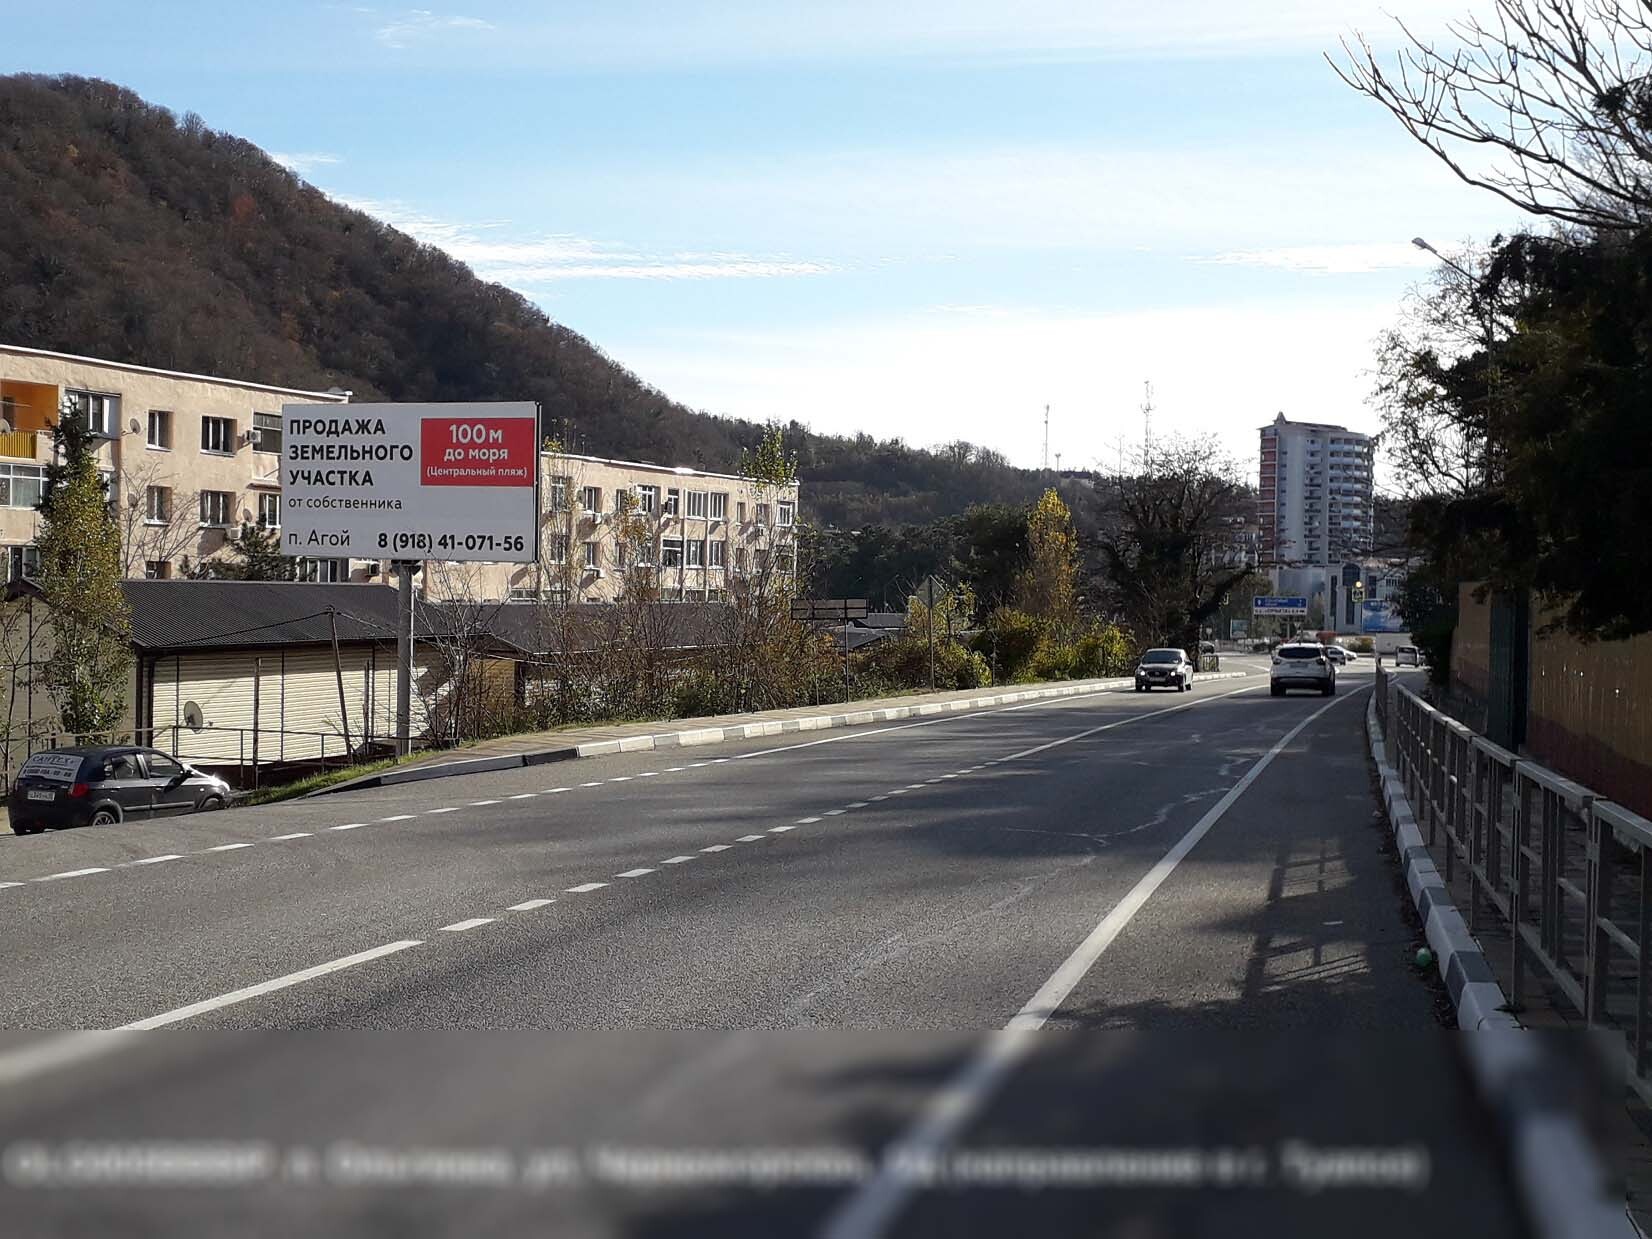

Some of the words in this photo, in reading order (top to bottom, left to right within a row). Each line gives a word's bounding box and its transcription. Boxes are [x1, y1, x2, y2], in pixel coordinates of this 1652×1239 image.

[289, 418, 386, 438] ПРОДАЖА
[449, 423, 487, 444] 100
[489, 431, 503, 443] м
[289, 444, 413, 461] ЗЕМЕЛЬНОГО
[444, 448, 465, 461] до
[468, 448, 509, 463] моря
[289, 469, 374, 486] УЧАСТКА
[426, 466, 496, 478] (Центральный
[498, 466, 528, 478] пляж)
[289, 498, 303, 509] от
[306, 496, 402, 510] собственника
[289, 533, 302, 545] п.
[308, 529, 350, 547] Агой
[378, 533, 388, 548] 8
[392, 533, 433, 552] (918)
[438, 534, 524, 552] 41-071-56
